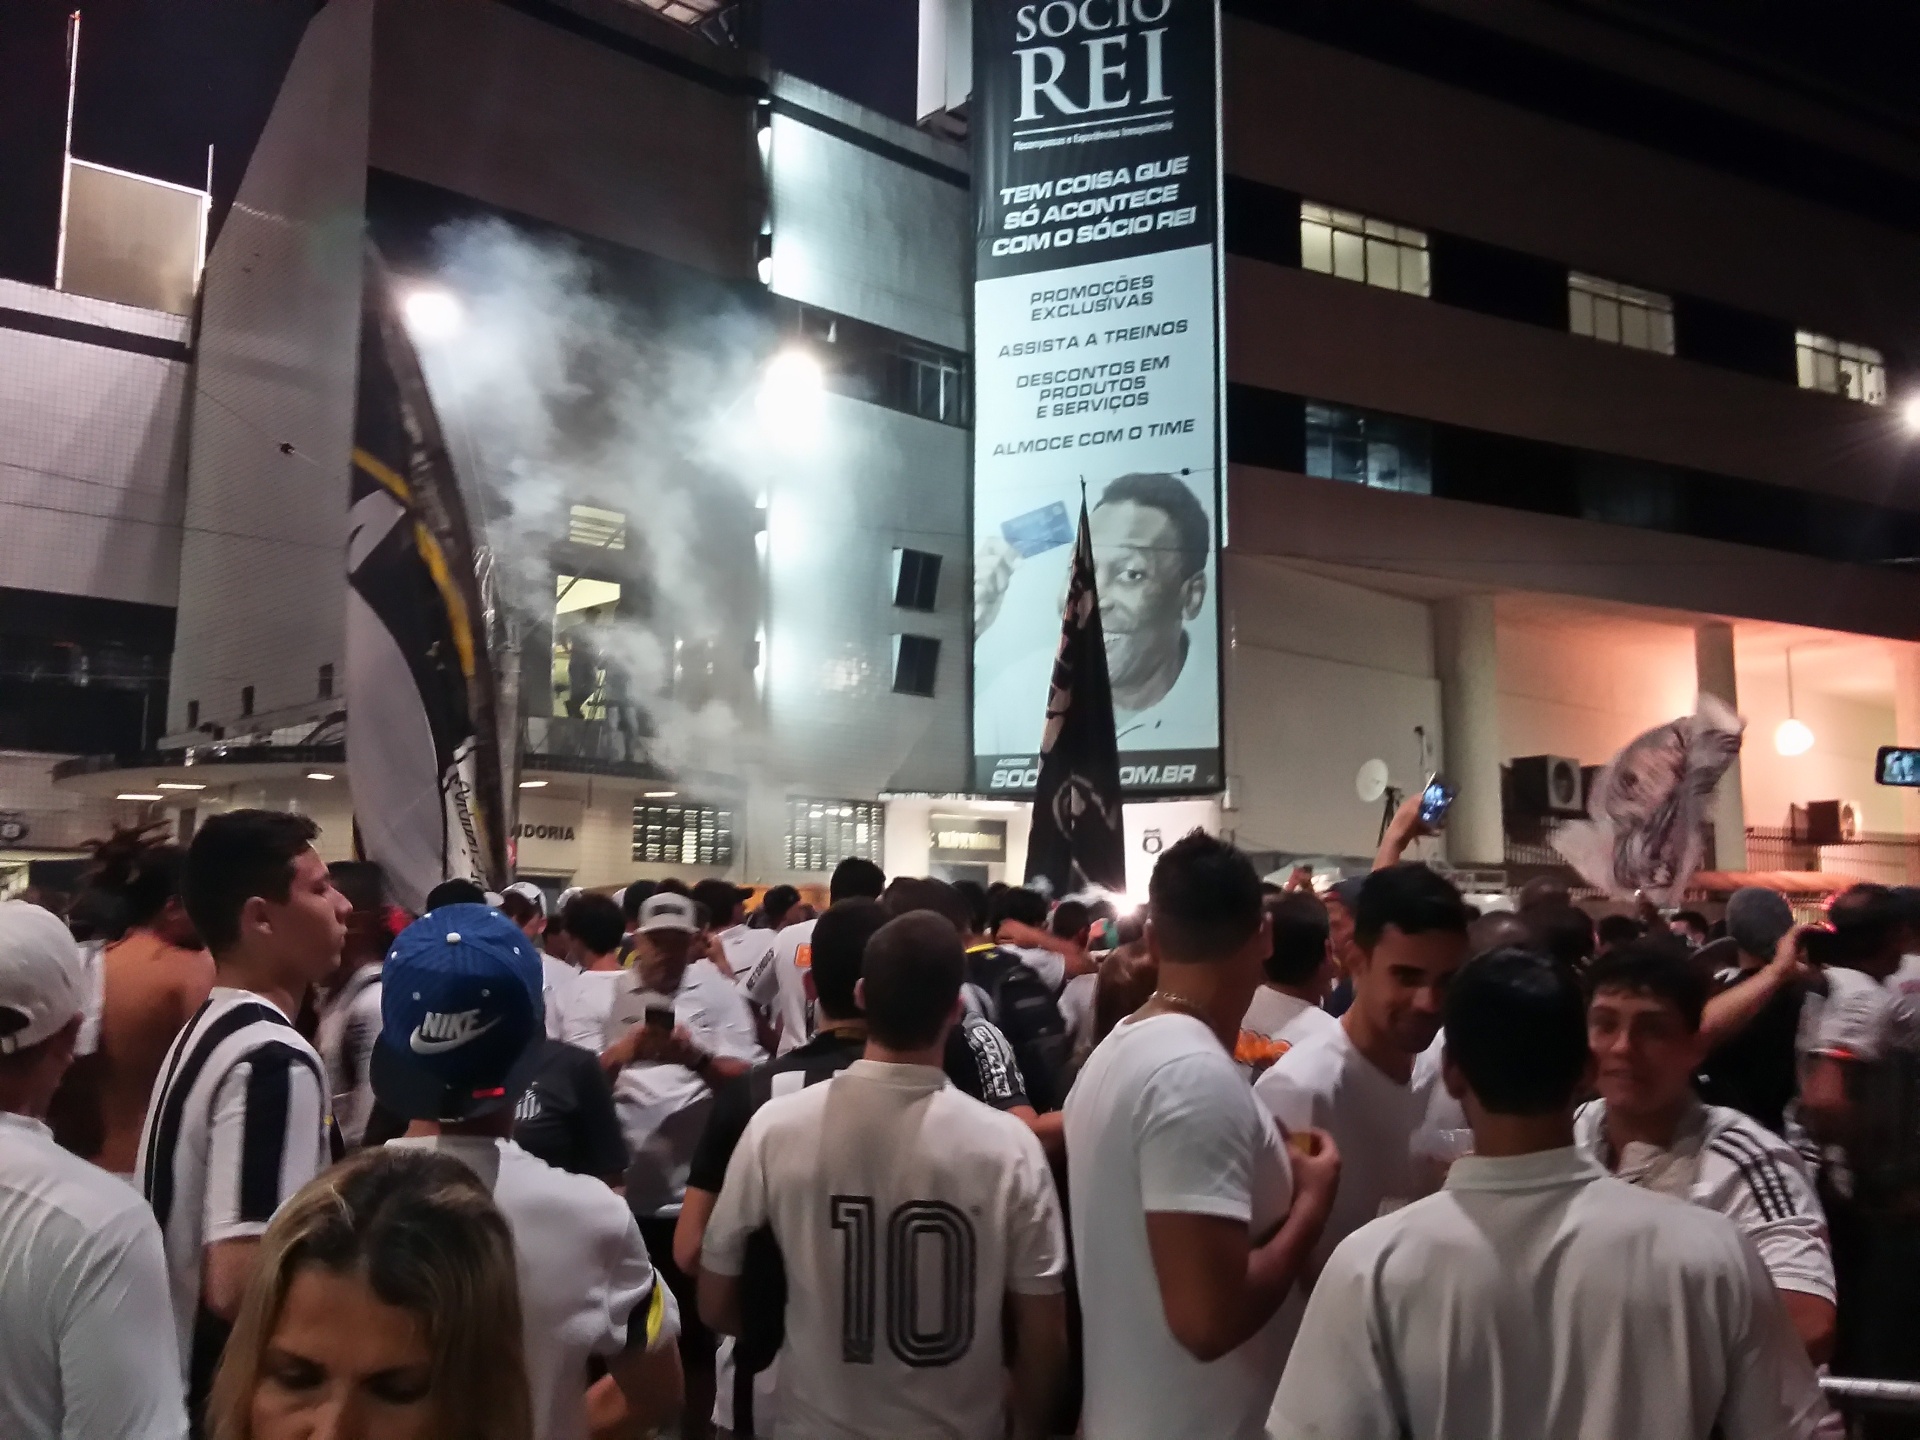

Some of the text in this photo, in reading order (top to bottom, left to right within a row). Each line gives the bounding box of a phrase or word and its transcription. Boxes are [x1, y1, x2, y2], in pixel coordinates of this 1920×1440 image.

[1012, 27, 1173, 122] REI
[1000, 155, 1190, 206] TEM COISA QUE
[1003, 183, 1180, 230] SÓ ACONTECE
[991, 206, 1197, 257] COM O SÓCIO REI
[1030, 274, 1154, 305] PROMOÇÕES
[1031, 291, 1154, 322] EXCLUSIVAS
[998, 318, 1189, 359] ASSISTA A TREINOS
[1015, 354, 1170, 389] DESCONTOS EM
[1039, 375, 1147, 402] PRODUTOS
[1036, 391, 1150, 419] E SERVIÇOS
[992, 418, 1196, 457] ALMOCE COM O TIME
[421, 1008, 480, 1039] NIKE
[830, 1194, 977, 1368] 10
